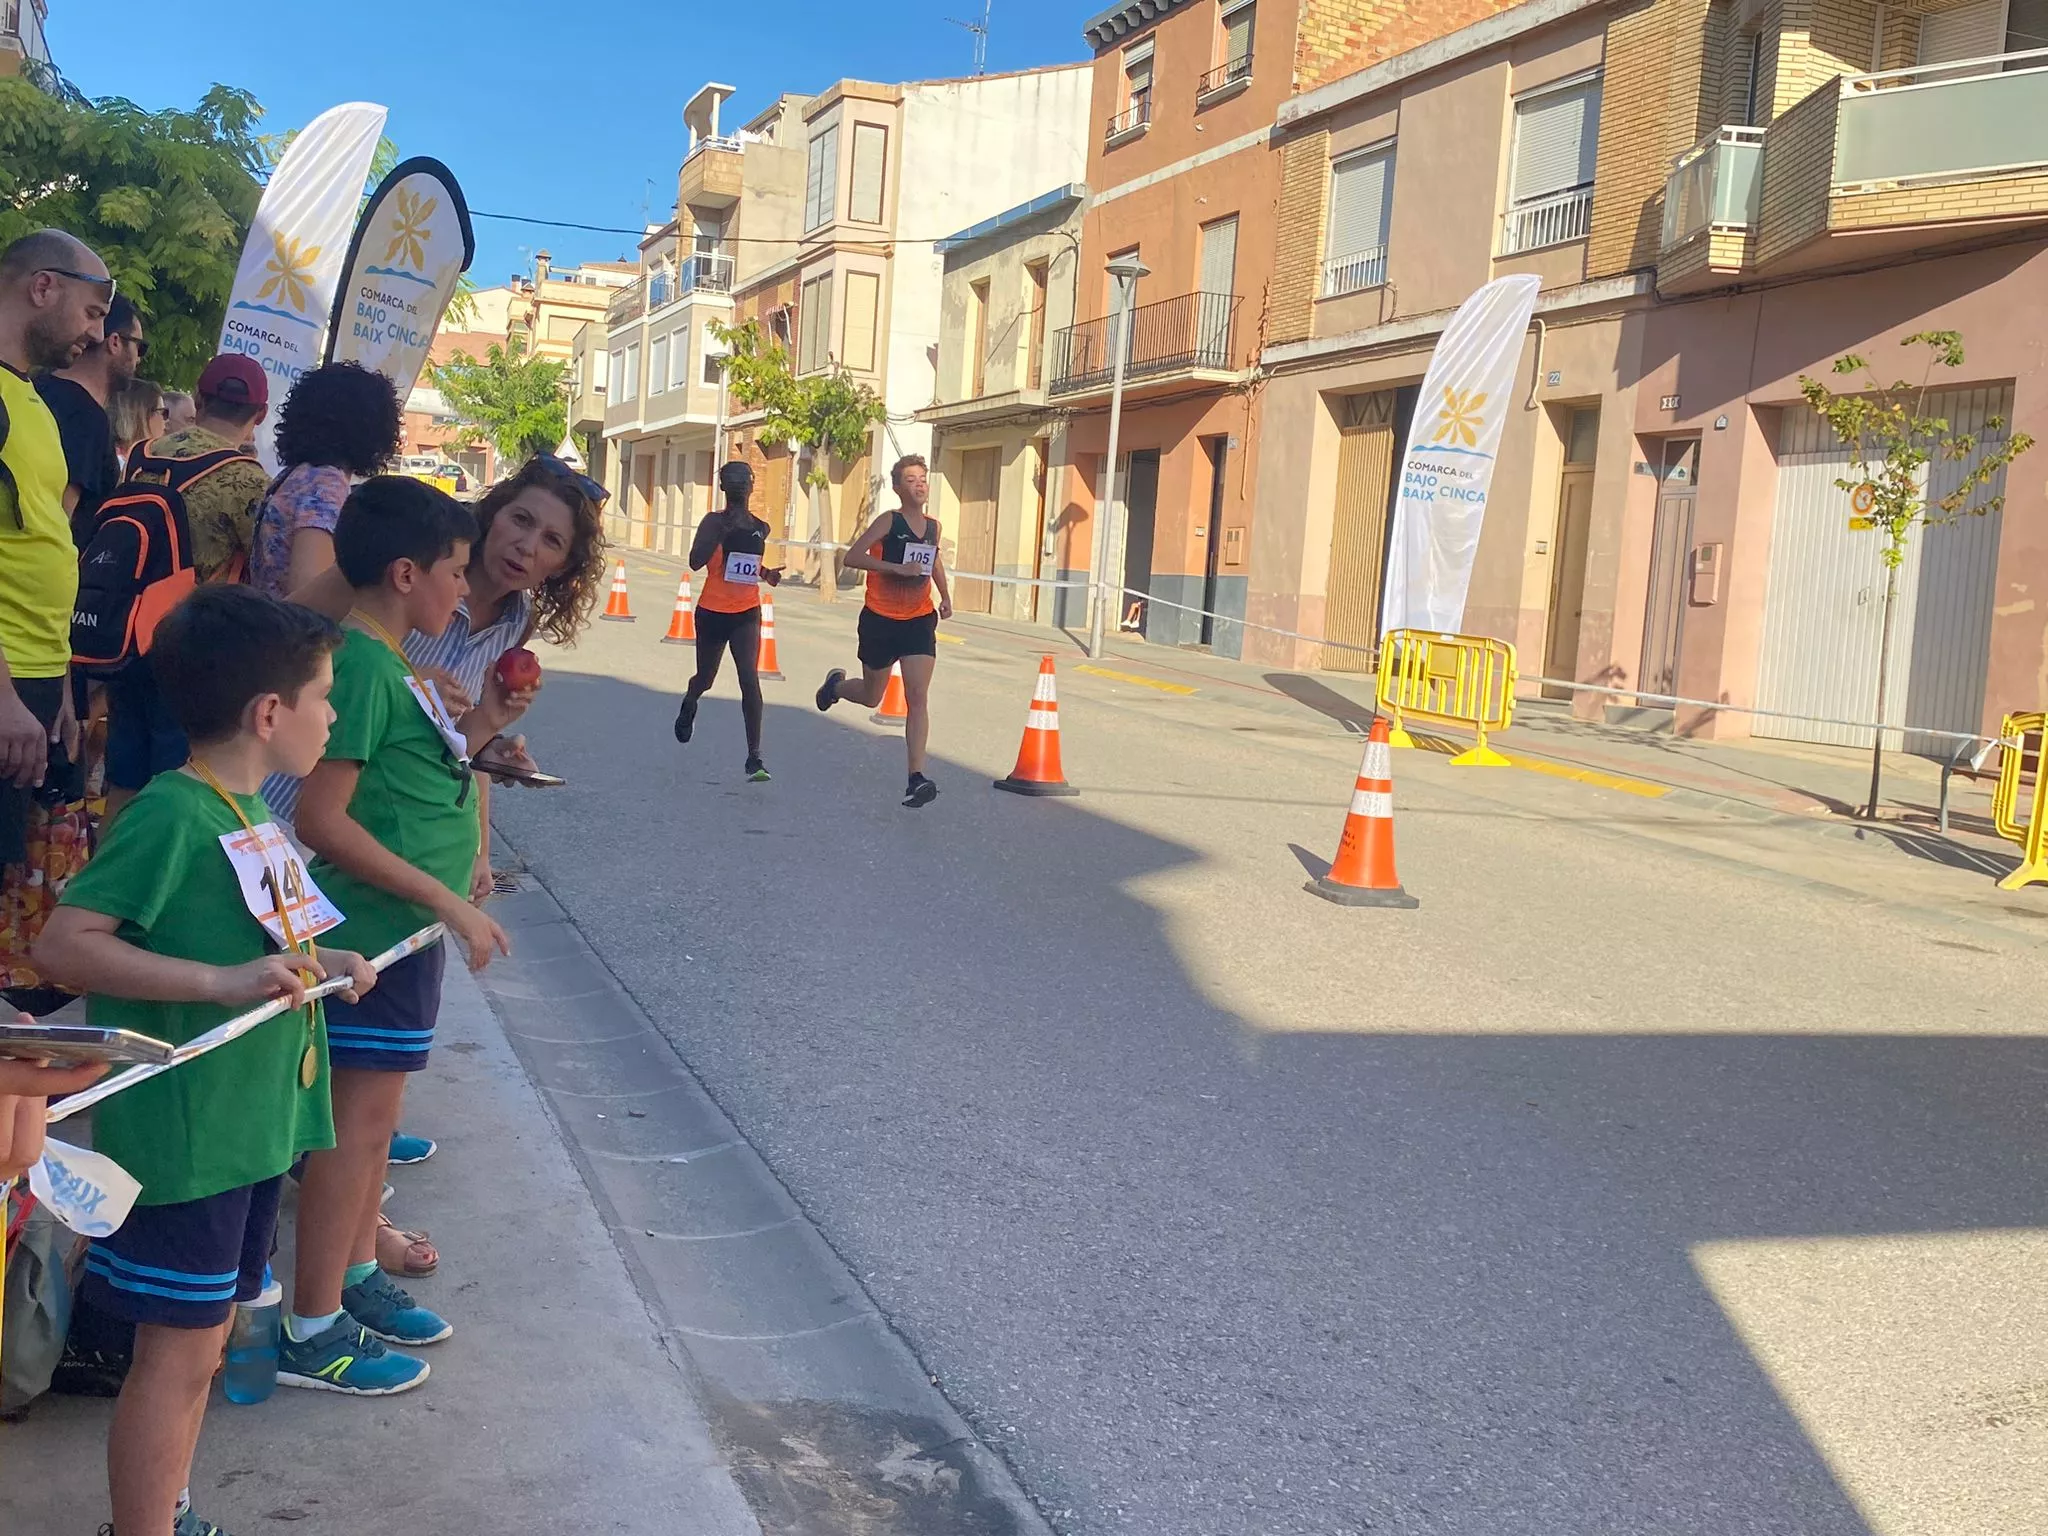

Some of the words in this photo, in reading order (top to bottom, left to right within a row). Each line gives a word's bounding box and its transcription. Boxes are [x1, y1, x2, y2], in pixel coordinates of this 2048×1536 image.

[360, 286, 405, 311] COMARCA
[356, 301, 387, 324] BAJO
[227, 319, 282, 347] COMARCA
[283, 340, 299, 353] DEL
[352, 321, 384, 345] BAIX
[223, 333, 261, 356] BAJO
[261, 356, 303, 381] CINC
[1405, 471, 1438, 488] BAJO
[1407, 460, 1457, 477] COMARCA
[1459, 470, 1474, 480] DEL
[1402, 486, 1435, 503] BAIX
[1440, 485, 1486, 504] CINCA
[910, 551, 931, 565] 105
[734, 561, 758, 577] 102
